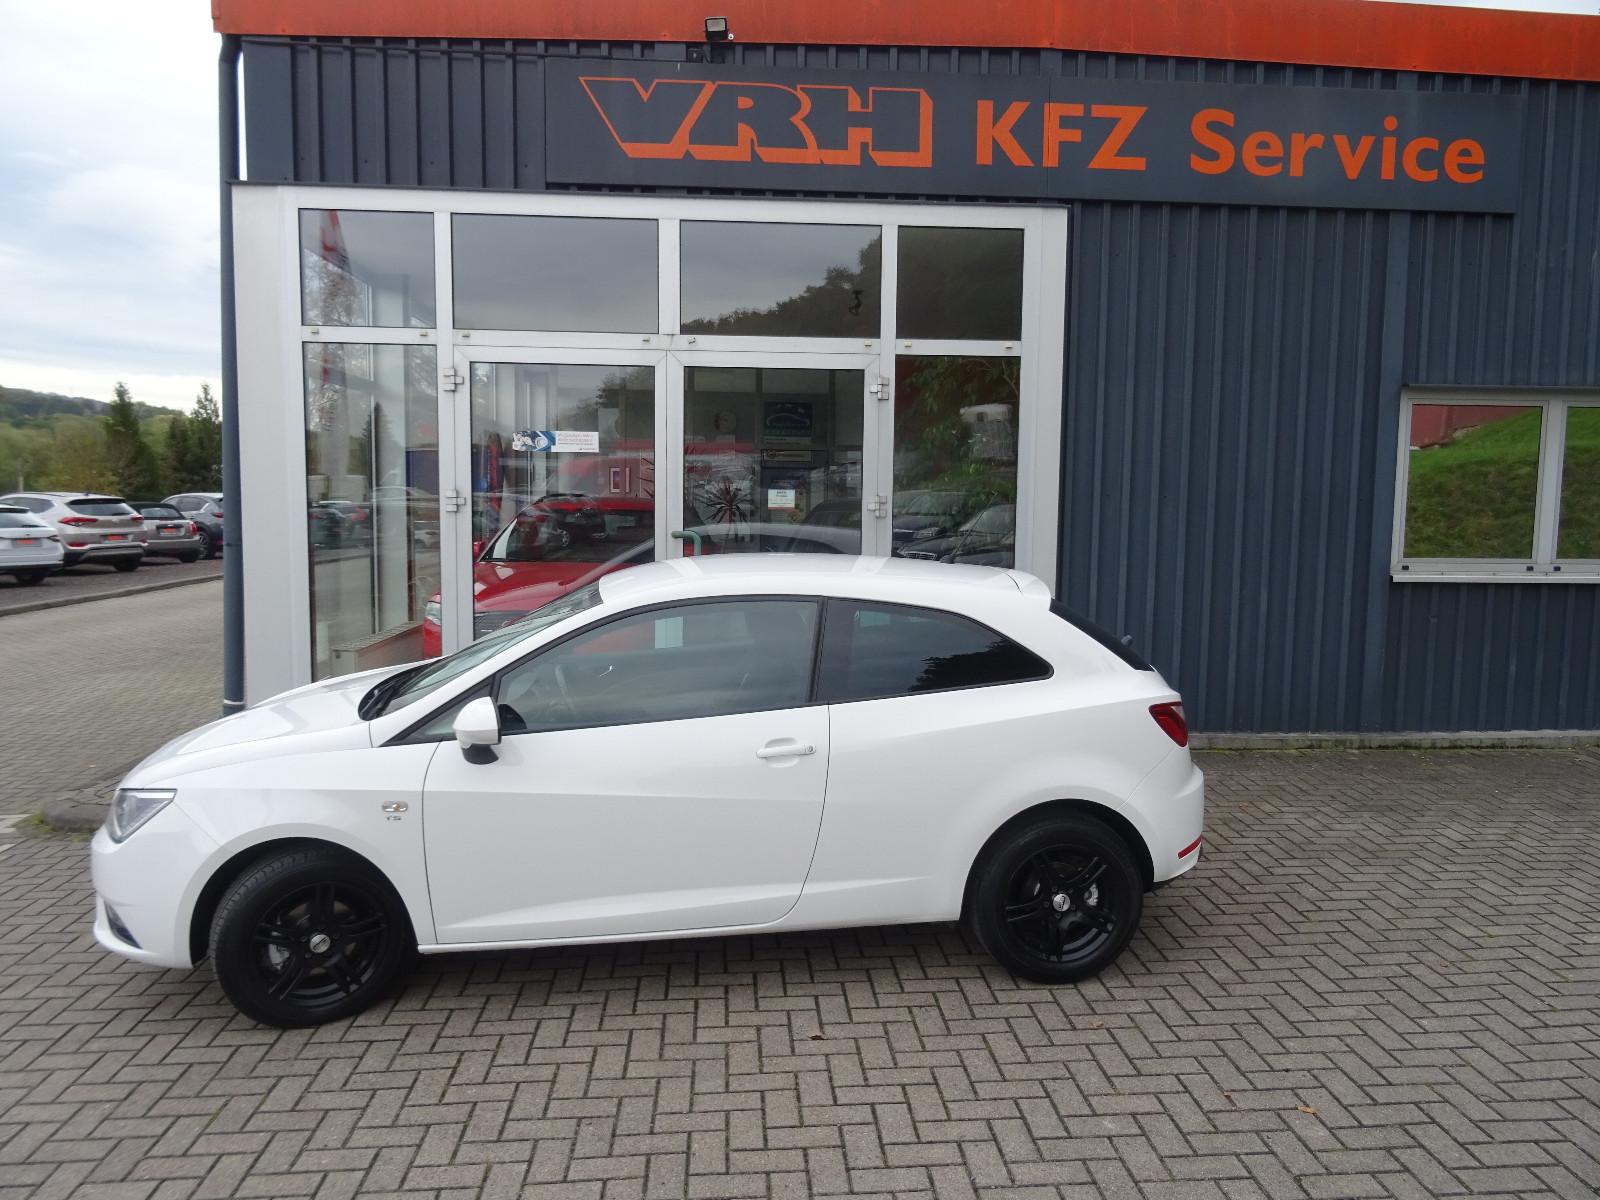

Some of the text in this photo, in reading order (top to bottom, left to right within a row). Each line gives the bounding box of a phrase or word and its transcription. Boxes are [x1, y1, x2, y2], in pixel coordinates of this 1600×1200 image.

[578, 76, 1485, 184] VRH KFZ Service
[848, 290, 864, 316] 3
